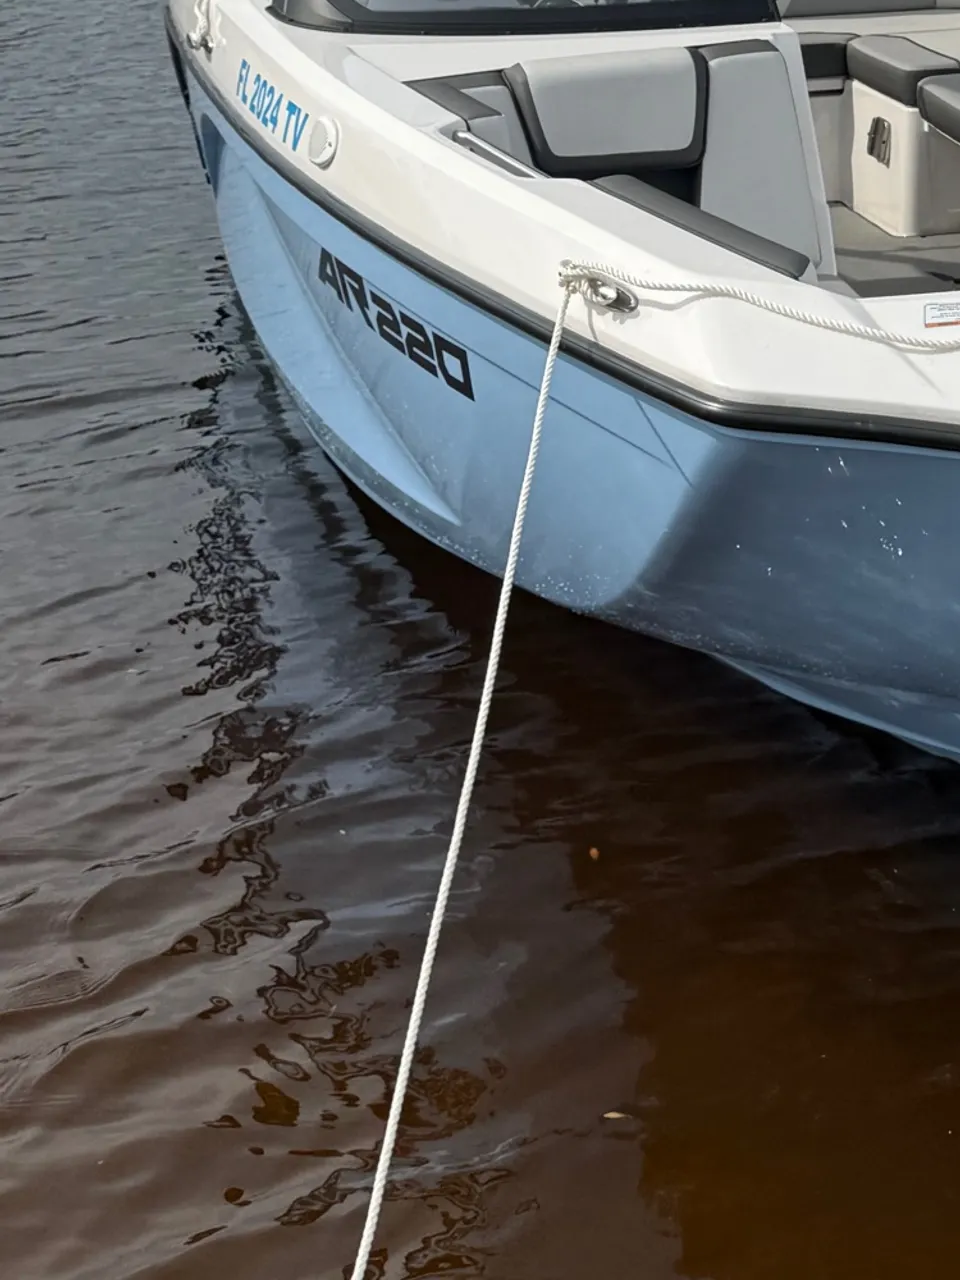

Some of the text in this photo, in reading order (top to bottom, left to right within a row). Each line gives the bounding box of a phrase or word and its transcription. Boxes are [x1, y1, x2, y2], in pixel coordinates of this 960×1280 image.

[236, 58, 310, 152] FL 2024 TV
[318, 247, 475, 402] AR220
